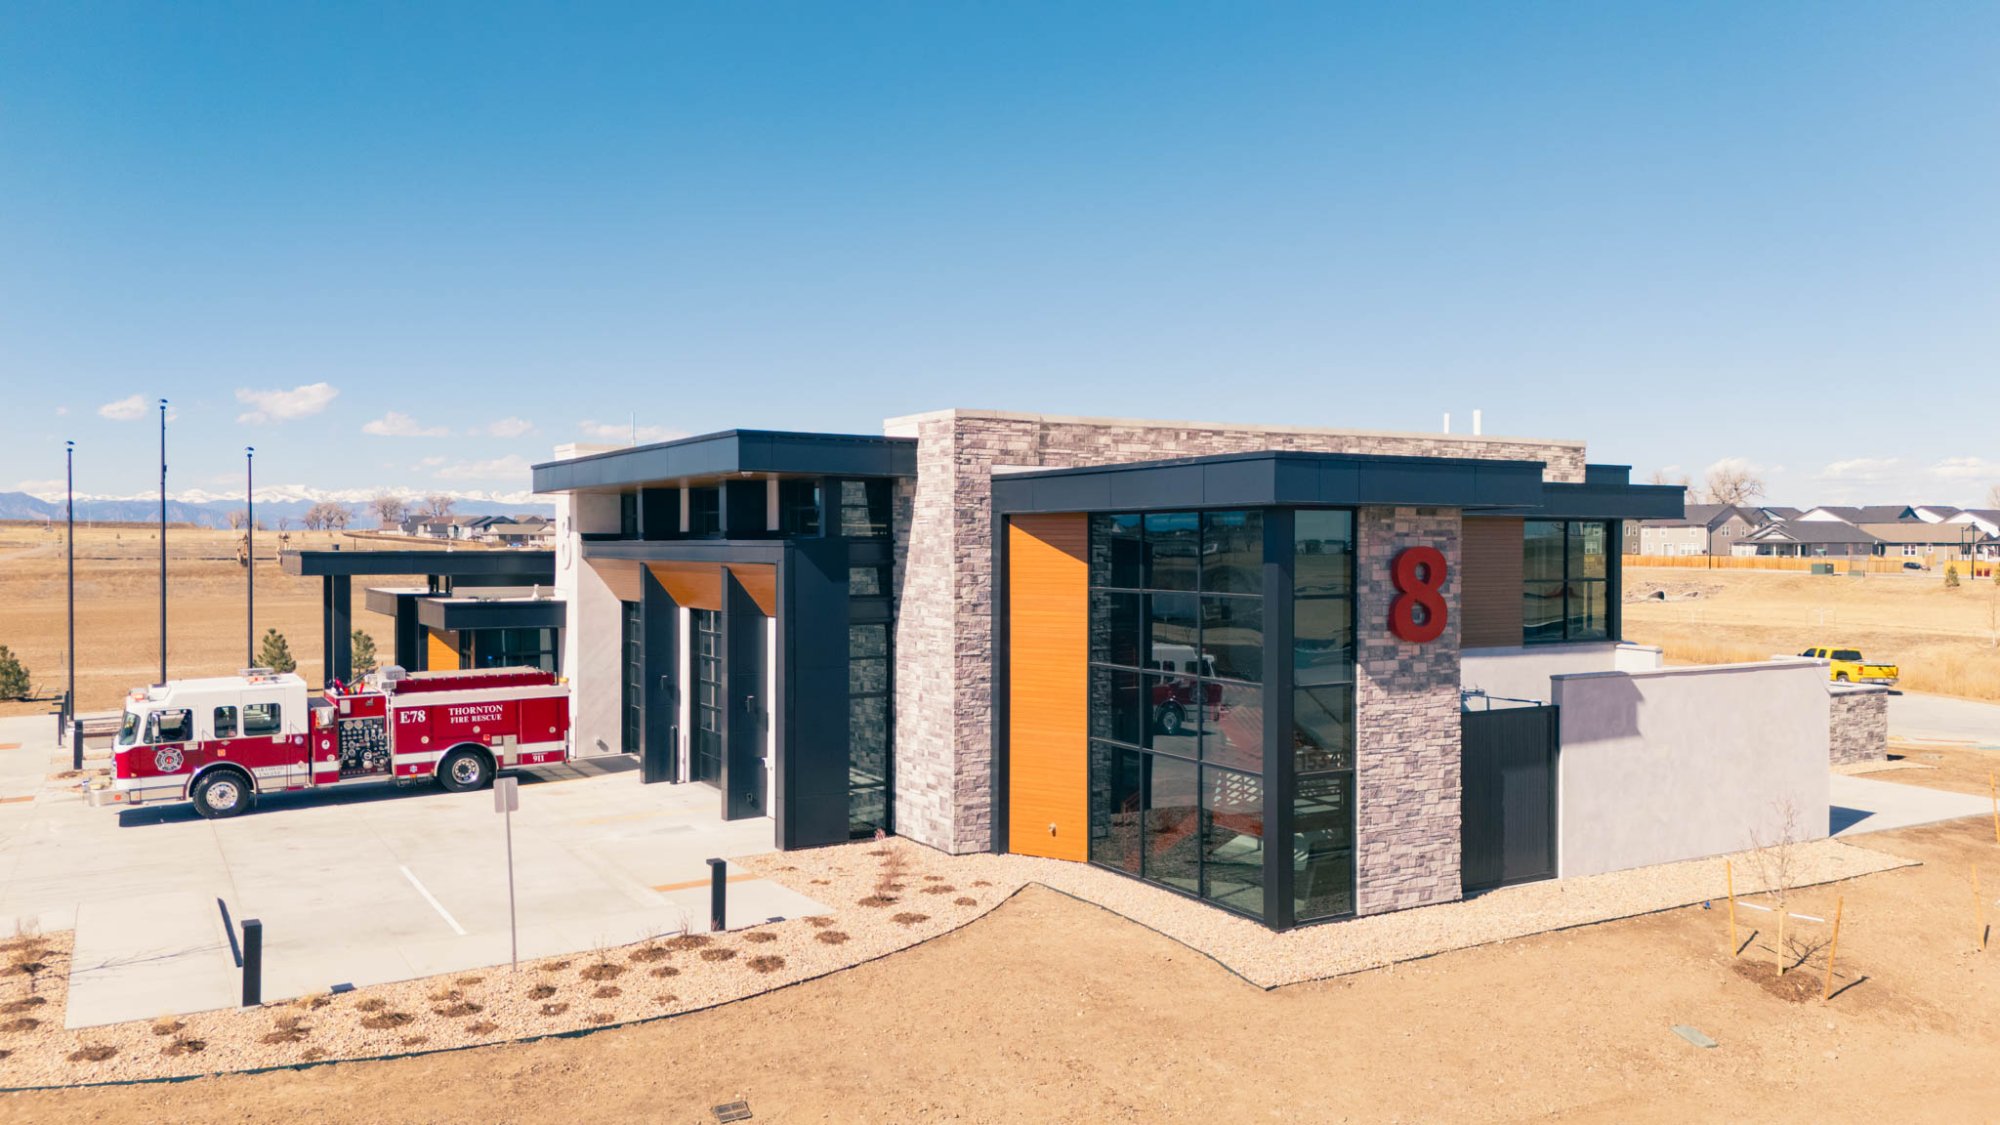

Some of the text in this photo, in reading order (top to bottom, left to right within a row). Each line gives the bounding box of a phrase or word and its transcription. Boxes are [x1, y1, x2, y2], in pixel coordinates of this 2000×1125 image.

[1388, 546, 1448, 643] 8
[448, 705, 503, 716] THORNTON
[400, 710, 426, 724] E78
[450, 714, 502, 724] FIRE RESCUE
[532, 755, 545, 763] 911
